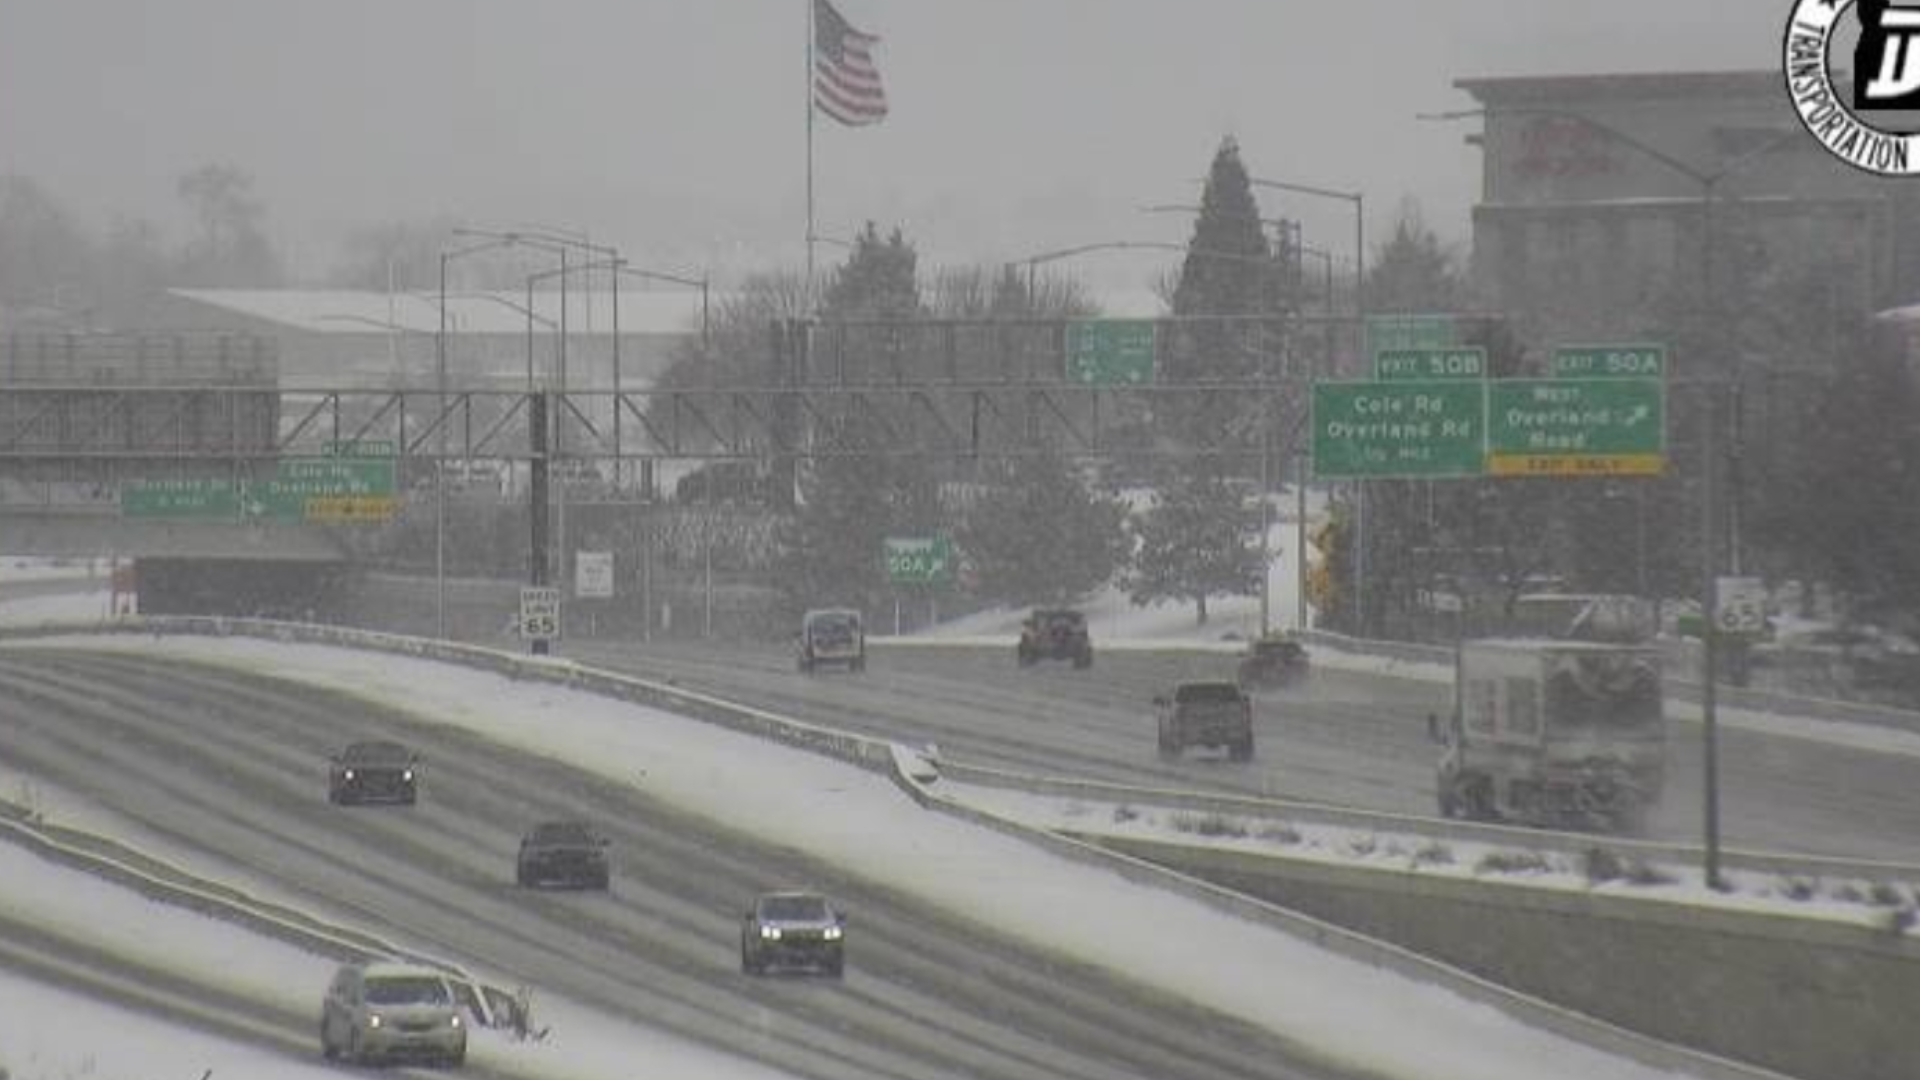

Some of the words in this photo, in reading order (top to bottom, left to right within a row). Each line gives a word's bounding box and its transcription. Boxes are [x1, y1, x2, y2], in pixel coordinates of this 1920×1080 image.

[1380, 357, 1417, 372] EXIT
[1430, 355, 1480, 374] 50B
[1557, 354, 1593, 370] EXIT
[1606, 352, 1658, 372] 50A
[1354, 396, 1402, 414] Cole
[1415, 394, 1442, 413] Rd
[1506, 408, 1610, 427] Overland
[1327, 420, 1432, 439] Overland
[1441, 419, 1470, 438] Rd
[527, 616, 555, 634] 65
[1722, 603, 1760, 628] 65
